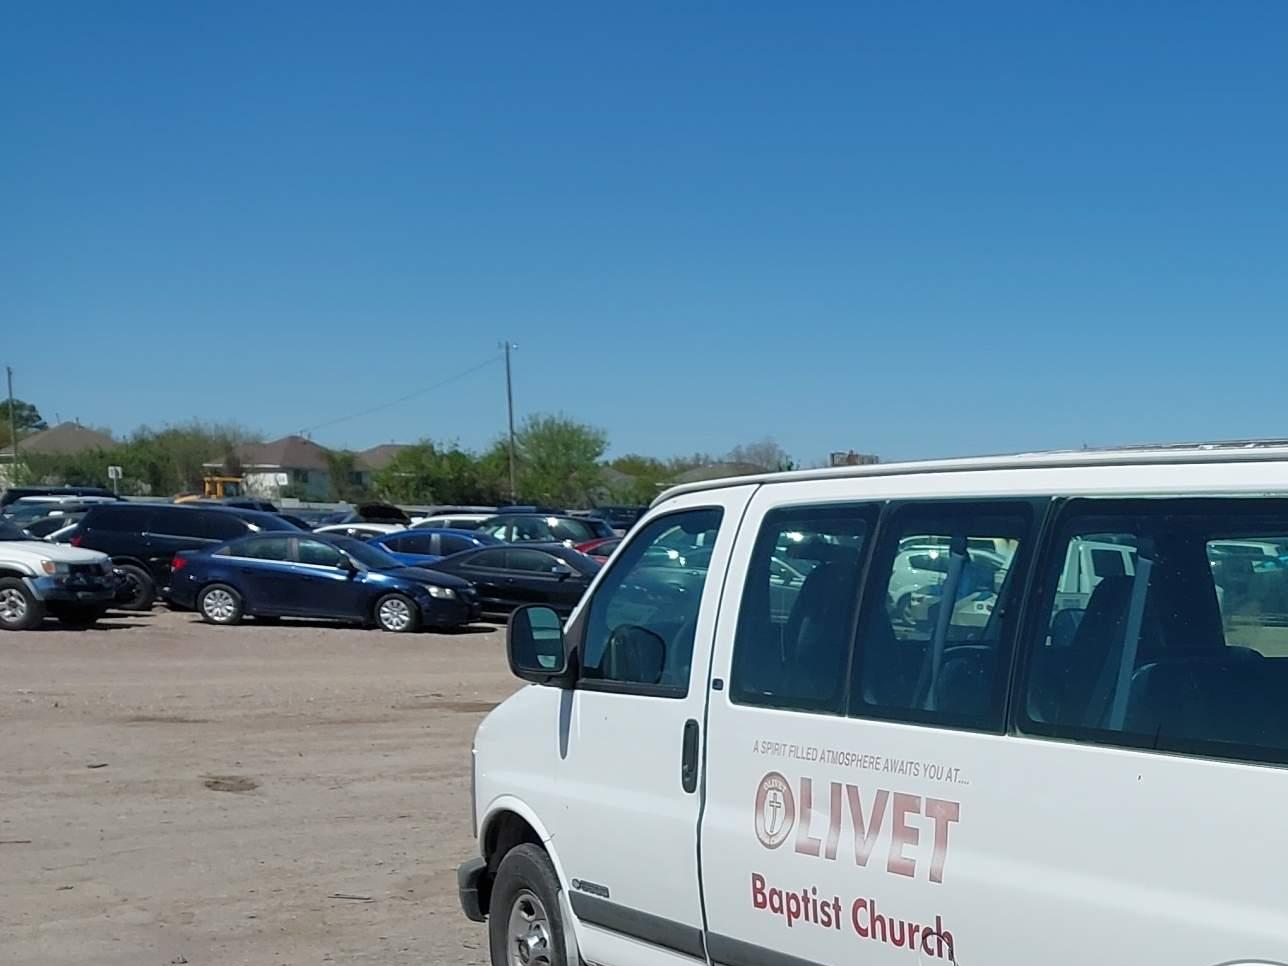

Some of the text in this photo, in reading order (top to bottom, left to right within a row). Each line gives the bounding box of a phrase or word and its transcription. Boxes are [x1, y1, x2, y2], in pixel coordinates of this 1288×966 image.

[760, 741, 787, 757] SPIRIT
[788, 745, 817, 761] FILLED
[819, 750, 881, 771] ATMOSPHERE
[882, 758, 920, 777] AWAITS
[923, 763, 944, 780] YOU
[755, 771, 960, 884] OLIVET
[752, 872, 956, 961] Baptist Church
